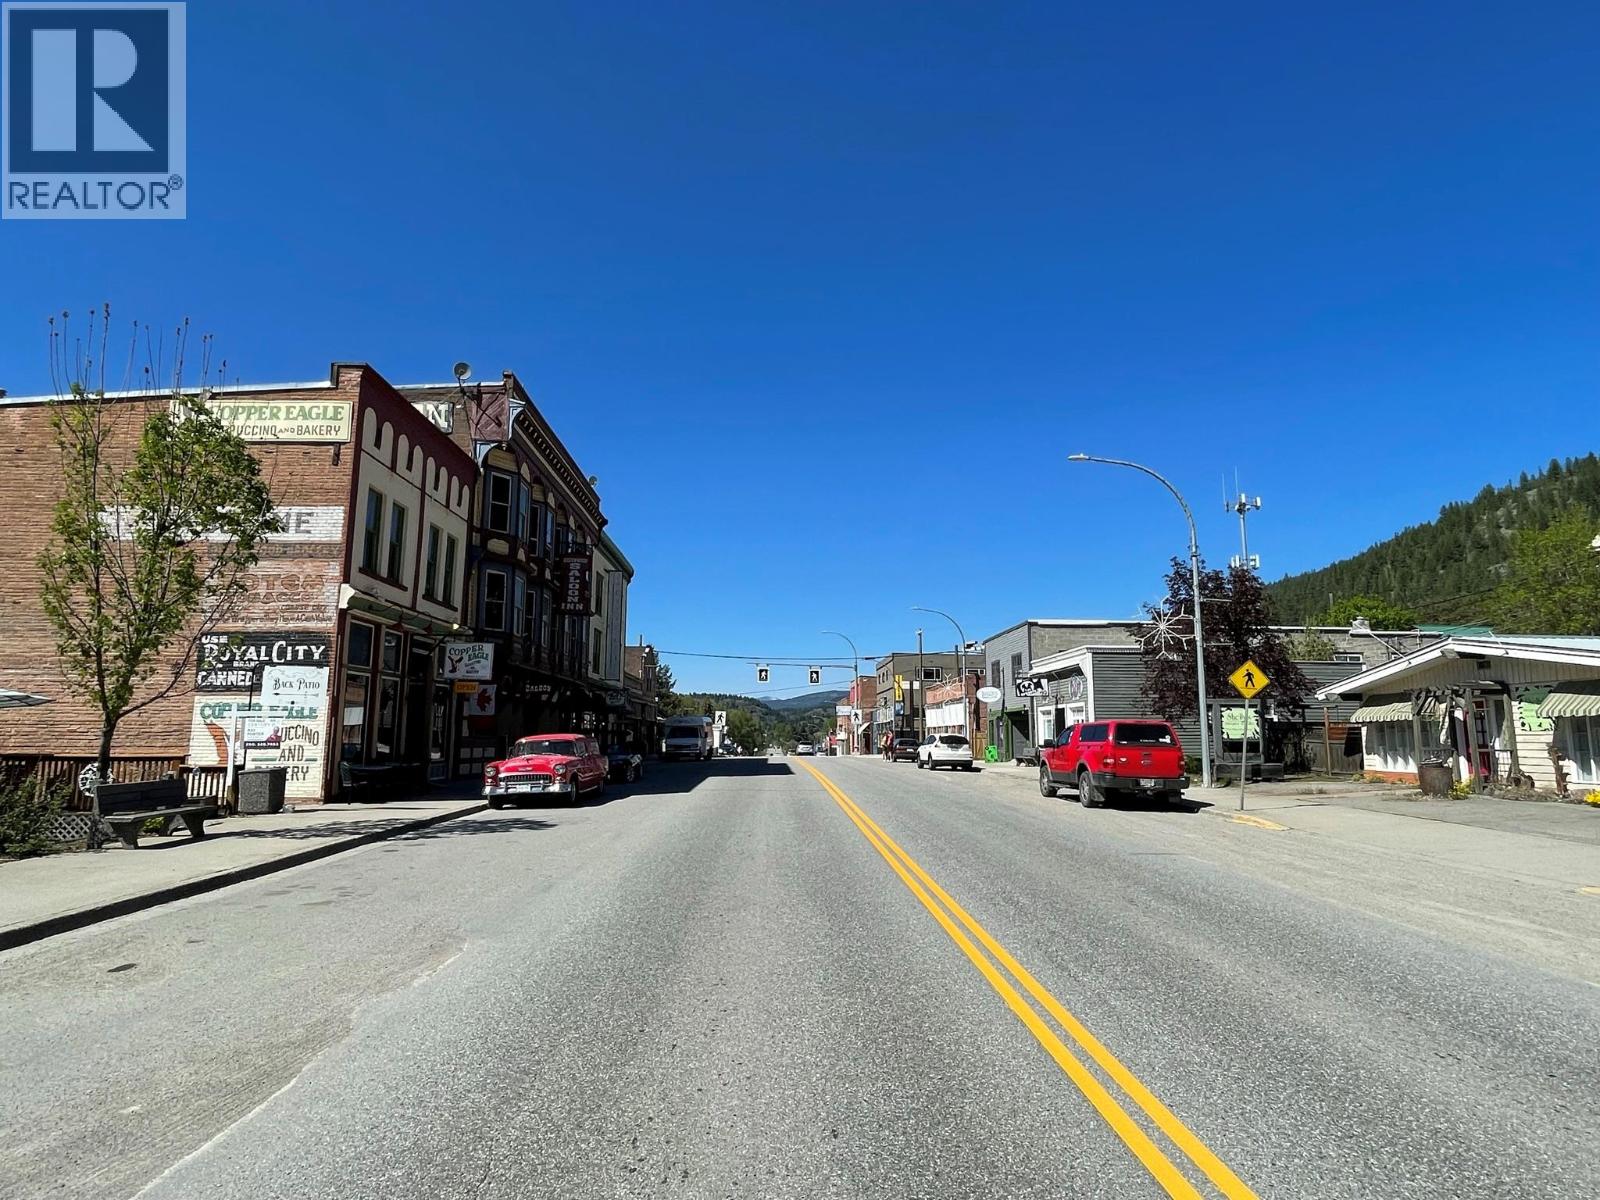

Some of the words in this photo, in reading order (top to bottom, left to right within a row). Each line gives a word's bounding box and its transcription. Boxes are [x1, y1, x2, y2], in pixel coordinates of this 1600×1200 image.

[212, 404, 280, 421] OPPER
[283, 405, 344, 421] EAGLE
[296, 424, 341, 436] BAKERY
[561, 602, 583, 610] INN
[200, 635, 228, 643] USE
[271, 641, 326, 662] CITY
[447, 645, 484, 656] COPPER
[467, 652, 488, 661] EAGLE
[273, 678, 294, 691] BACK
[297, 677, 320, 690] PATIO
[278, 745, 305, 761] AND
